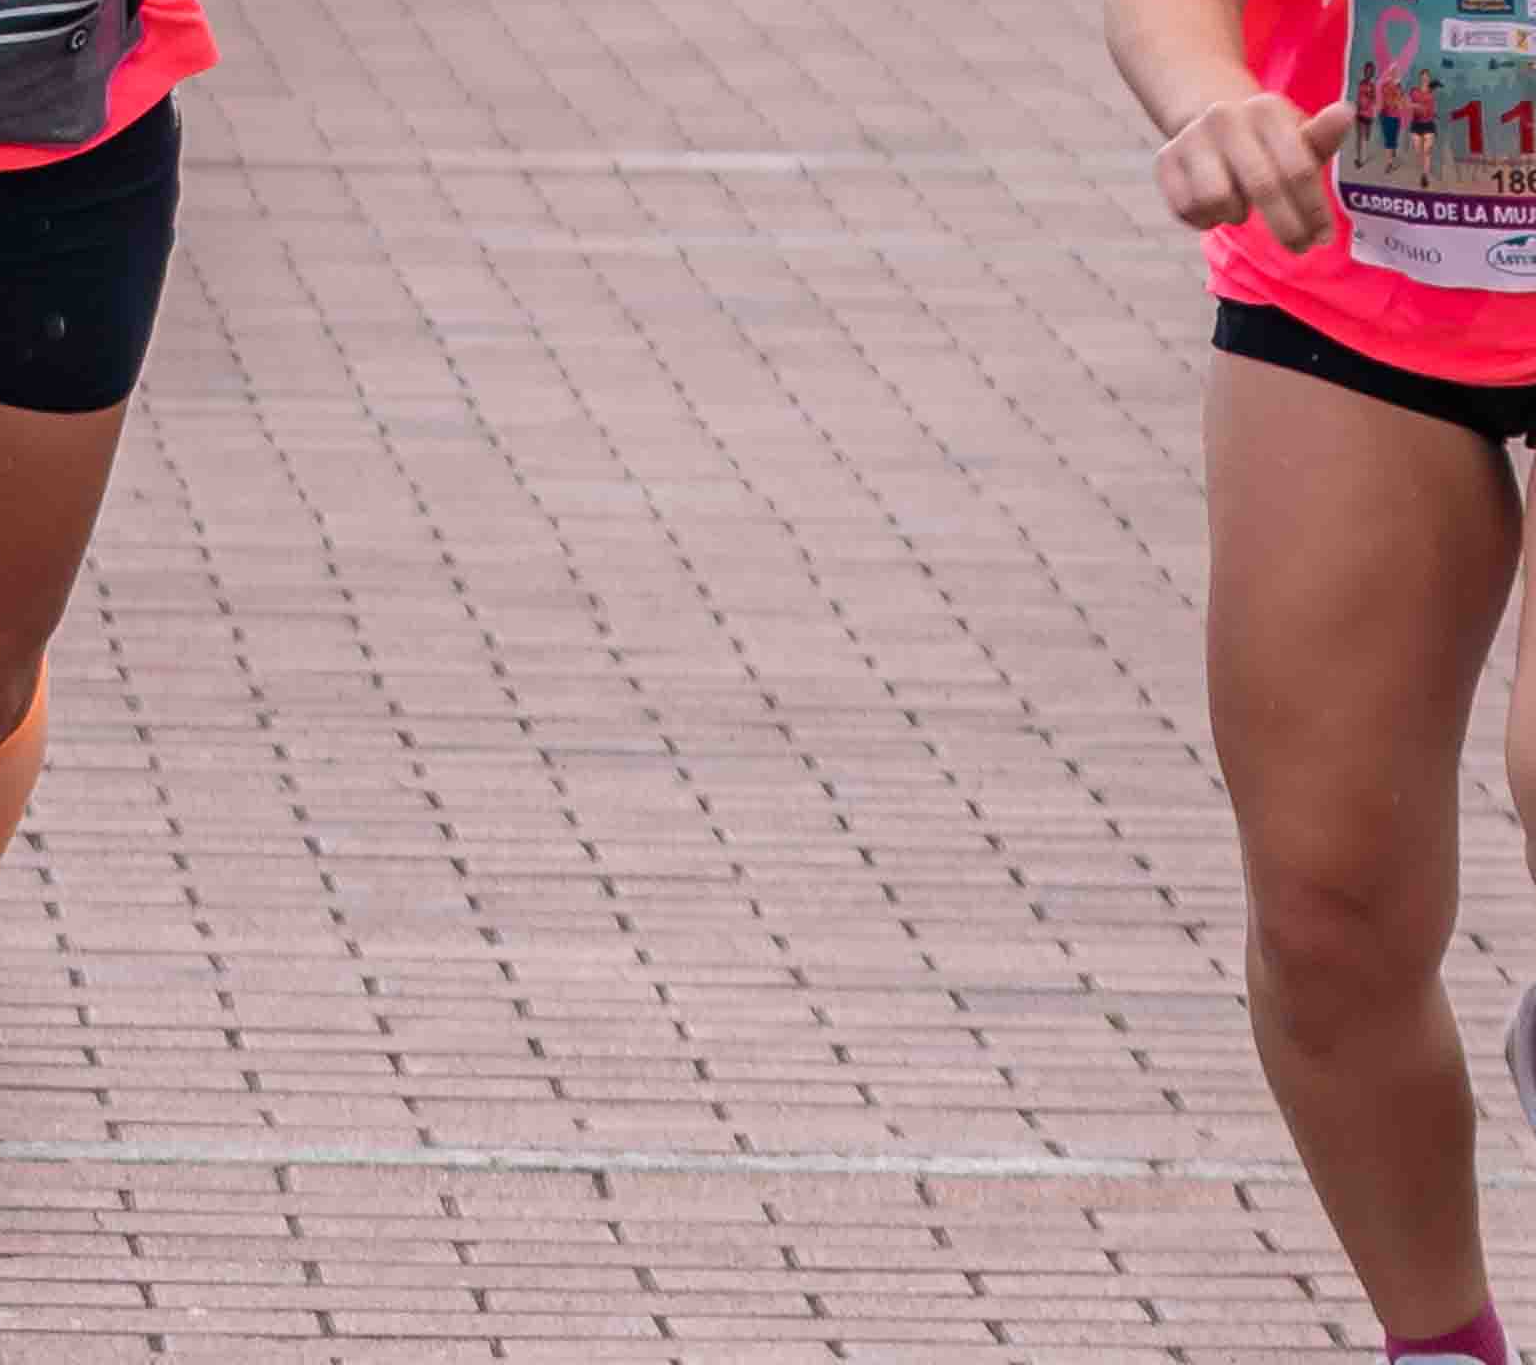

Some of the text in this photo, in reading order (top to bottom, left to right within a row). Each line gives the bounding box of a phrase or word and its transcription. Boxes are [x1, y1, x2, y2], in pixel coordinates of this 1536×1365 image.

[1348, 191, 1429, 221] CARRERA
[1432, 203, 1459, 223] DE
[1463, 204, 1489, 225] LA
